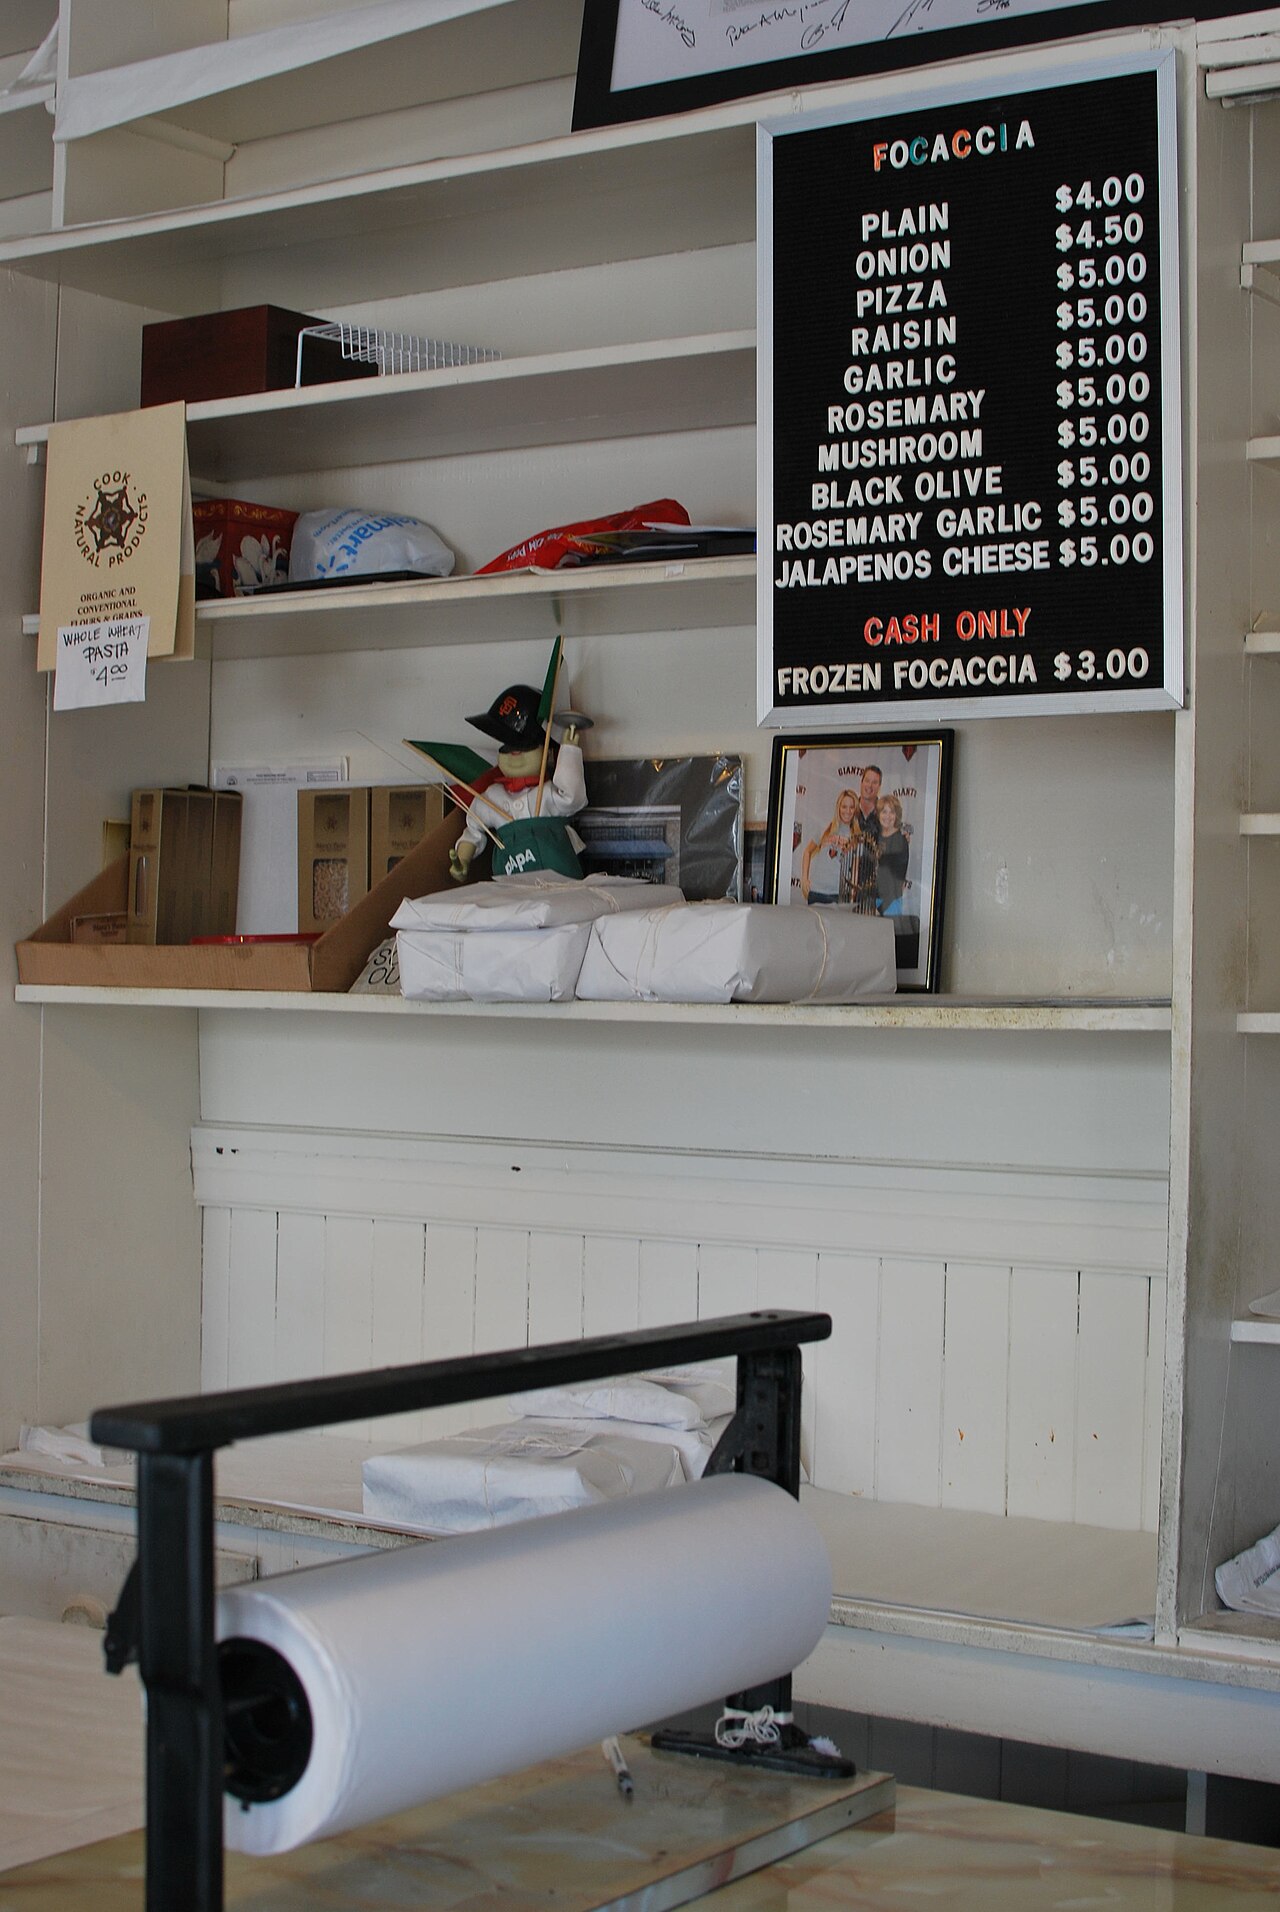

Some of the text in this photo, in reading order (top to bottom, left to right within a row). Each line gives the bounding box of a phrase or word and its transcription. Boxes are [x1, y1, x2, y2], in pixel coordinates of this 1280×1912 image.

[873, 120, 1034, 171] FOCACCIA
[862, 173, 1144, 241] PLAIN $4.00
[856, 213, 1143, 280] ONION $4.50
[857, 252, 1146, 317] PIZZA $5.00
[852, 292, 1147, 355] RAISIN $5.00
[844, 332, 1147, 394] GARLIC $5.00
[828, 372, 1149, 433] ROSEMARY $5.00
[819, 412, 1149, 471] MUSHROOM $5.00
[93, 470, 131, 491] COOK
[812, 452, 1150, 510] BLACK OLIVE $5.00
[74, 493, 148, 568] NATURAL PRODUCTS
[777, 492, 1153, 551] ROSEMARY GARLIC $5.00
[775, 532, 1153, 588] JALAPENOS CHEESE $5.00
[77, 598, 138, 615] CONVENTIONAL
[80, 585, 136, 603] ORGANIC AND
[112, 610, 143, 621] GRAINS
[63, 624, 145, 647] WHOLE WHEAT
[83, 641, 129, 664] PASTA
[864, 608, 1031, 645] CASH ONLY
[778, 648, 1148, 696] FROZEN FOCACCIA $3.00
